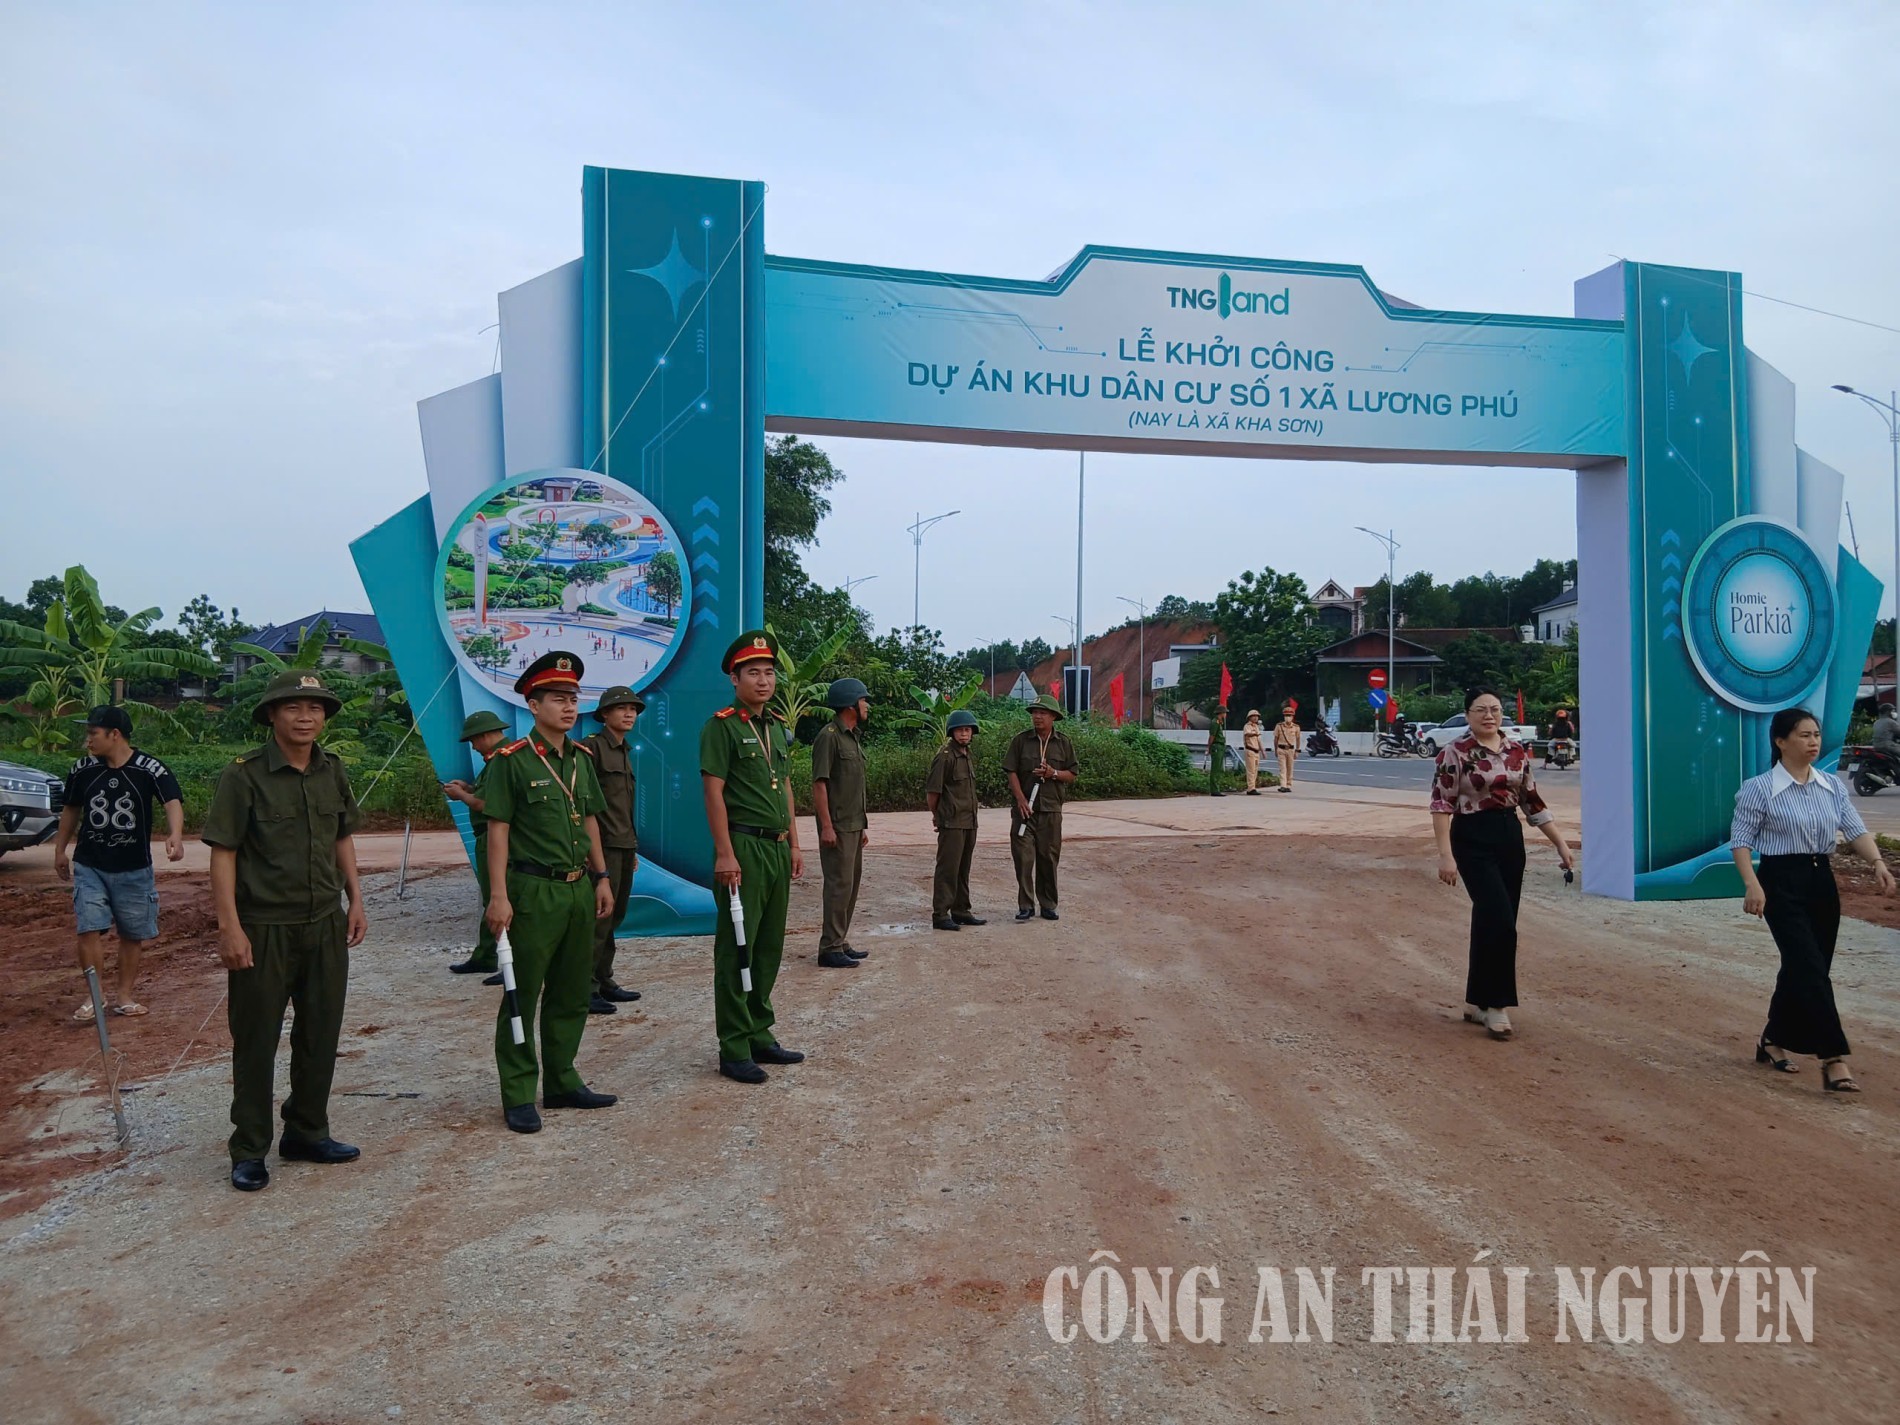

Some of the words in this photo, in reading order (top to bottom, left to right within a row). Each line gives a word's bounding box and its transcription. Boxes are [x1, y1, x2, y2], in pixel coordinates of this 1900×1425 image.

[1118, 327, 1156, 363] LỄ
[1165, 335, 1240, 367] KHỞI
[1250, 341, 1334, 373] CÔNG
[907, 362, 960, 395] DỰ
[968, 360, 1013, 393] ÁN
[1024, 371, 1090, 398] KHU
[1101, 370, 1164, 402] DÂN
[1174, 381, 1221, 405] CƯ
[1230, 374, 1270, 407] SỐ
[1279, 386, 1290, 408] 1
[1299, 383, 1338, 411] XÃ
[1347, 390, 1452, 416] LƯƠNG
[1461, 390, 1518, 418] PHÚ
[1128, 411, 1173, 429] (NAY
[1177, 410, 1200, 428] LÀ
[1205, 412, 1230, 430] XÃ
[1235, 416, 1273, 431] KHA
[1278, 418, 1324, 437] SƠN)
[1730, 592, 1767, 604] Homie
[1730, 606, 1792, 635] Parkia
